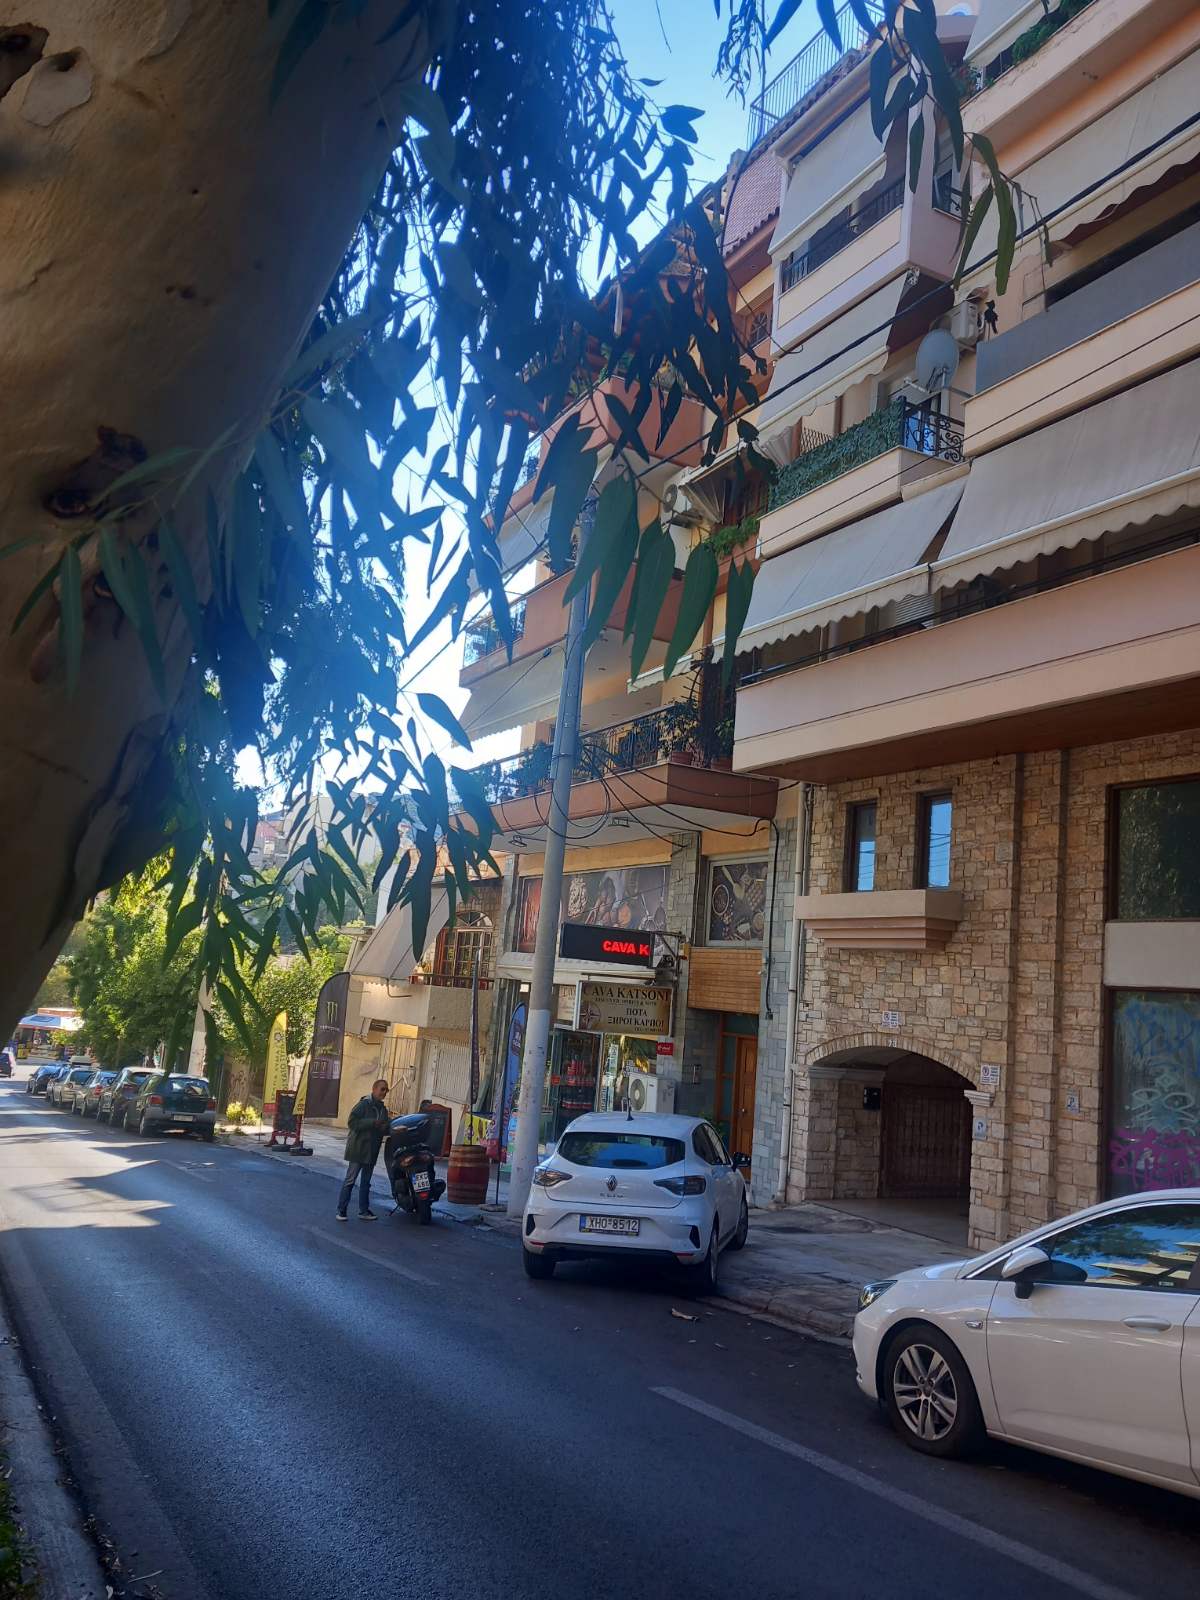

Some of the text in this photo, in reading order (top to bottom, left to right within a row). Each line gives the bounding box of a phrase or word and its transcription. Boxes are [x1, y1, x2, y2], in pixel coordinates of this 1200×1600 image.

[602, 940, 650, 956] CAVA K
[583, 985, 614, 998] CAVA
[617, 988, 669, 1002] KATSONI
[626, 1007, 648, 1017] ΠΟΤΑ
[589, 1217, 638, 1231] XHO-8512
